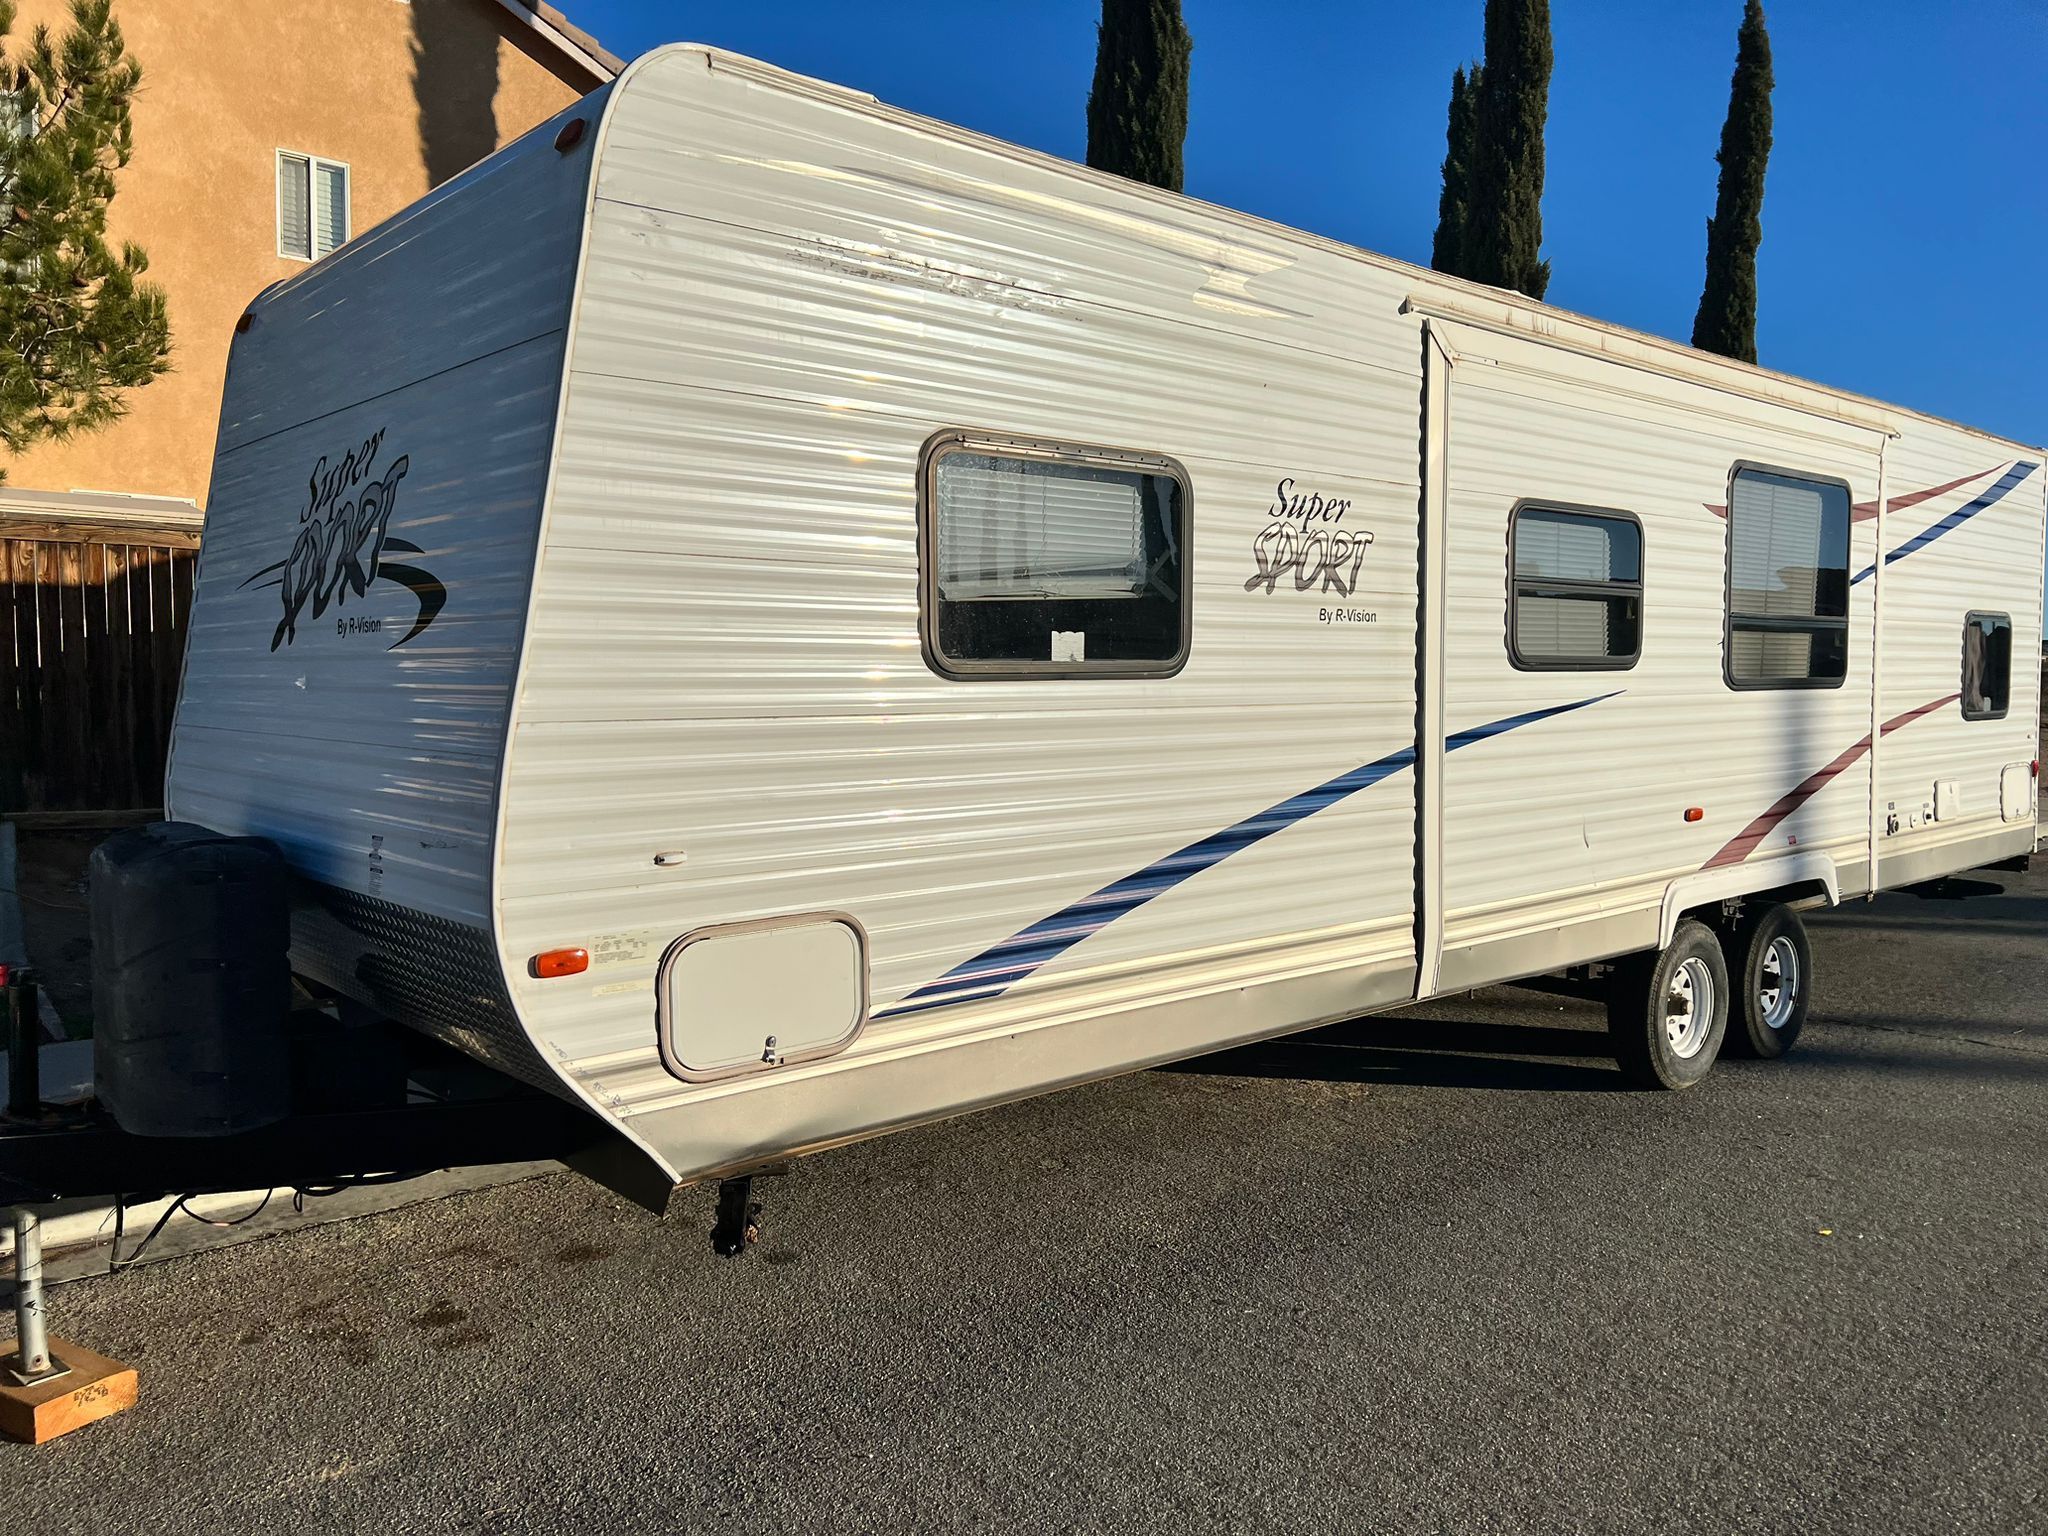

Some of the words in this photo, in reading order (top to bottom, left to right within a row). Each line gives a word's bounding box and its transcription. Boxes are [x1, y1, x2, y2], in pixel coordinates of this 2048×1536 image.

[299, 426, 387, 528] Super
[1267, 477, 1352, 534] Super
[270, 454, 409, 653] SPORT
[1243, 520, 1375, 599] SPORT
[337, 618, 348, 639] By
[349, 615, 382, 634] R-Vision
[1319, 608, 1333, 625] By
[1335, 608, 1377, 623] R-Vision
